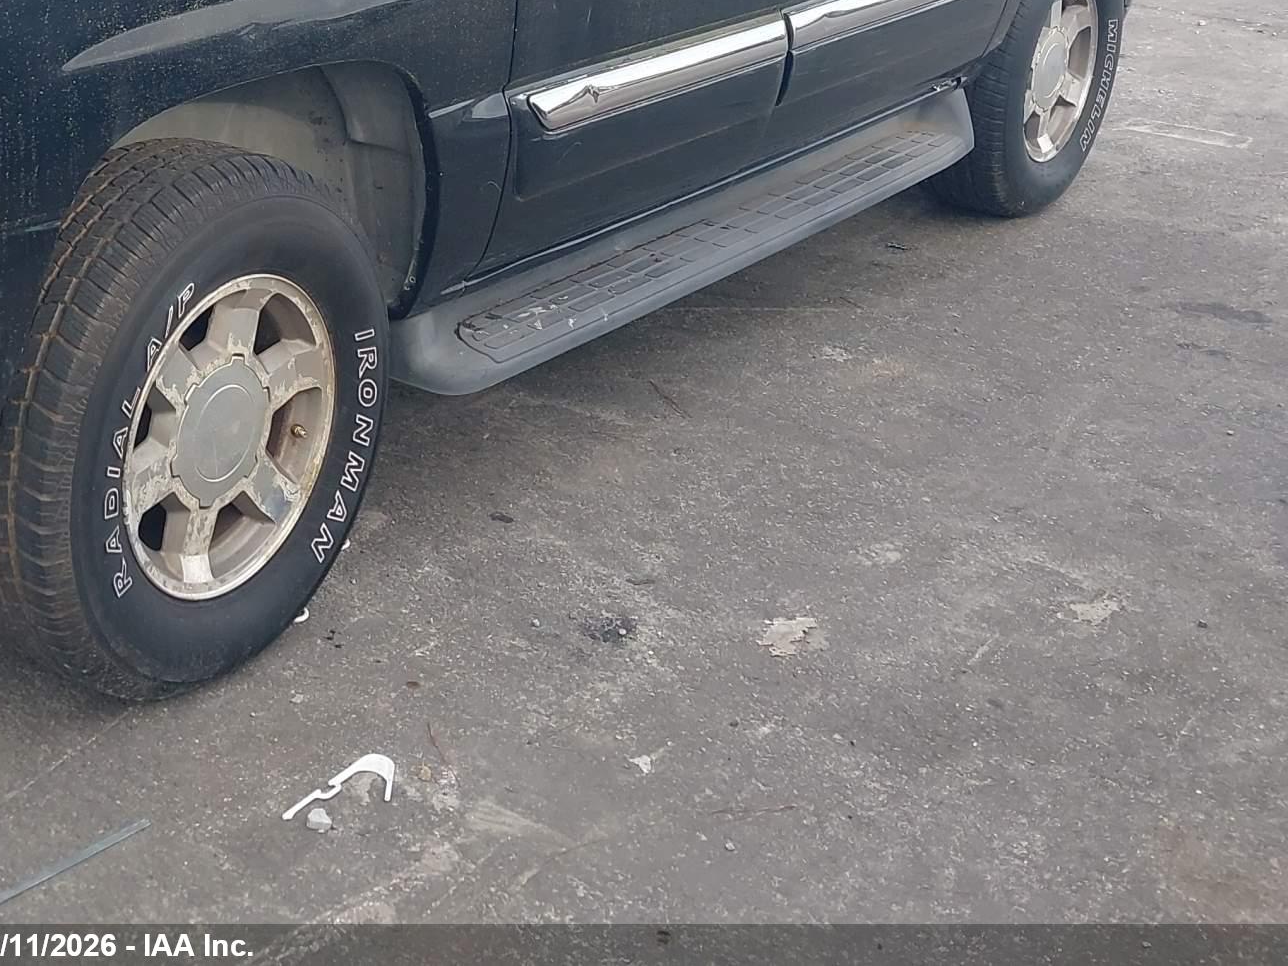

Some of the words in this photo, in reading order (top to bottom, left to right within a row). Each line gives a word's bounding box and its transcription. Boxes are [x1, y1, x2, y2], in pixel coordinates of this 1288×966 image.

[1079, 18, 1119, 152] MICHELIN
[102, 385, 143, 599] RADIAL
[145, 281, 196, 374] A/P
[311, 328, 380, 564] IRONMAN
